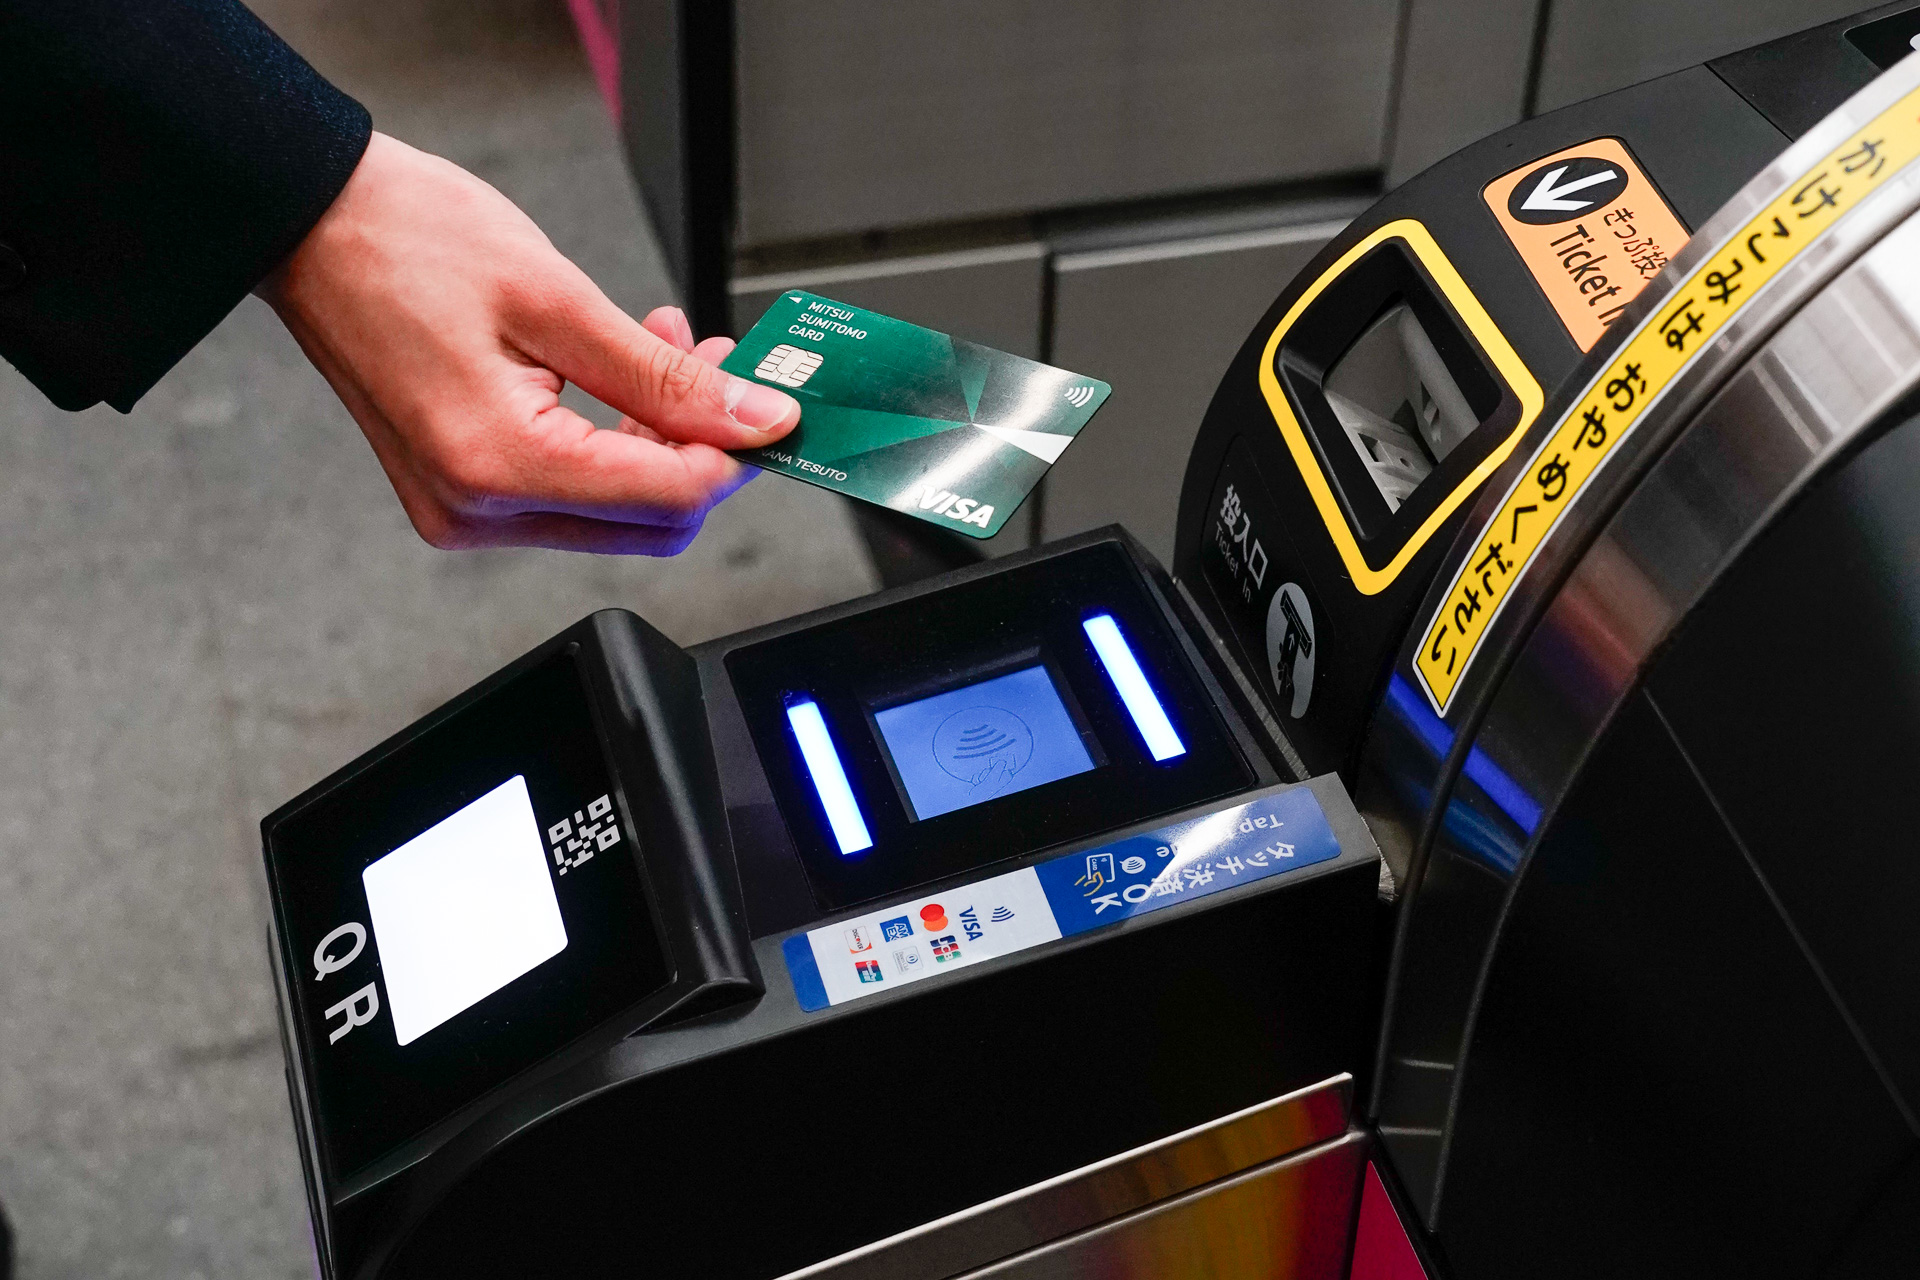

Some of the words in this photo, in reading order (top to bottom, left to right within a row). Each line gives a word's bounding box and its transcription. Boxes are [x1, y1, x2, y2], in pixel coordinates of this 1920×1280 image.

[1604, 207, 1668, 280] きっぷ投
[1659, 139, 1884, 353] かけこみは
[1550, 224, 1622, 306] Ticket
[1598, 301, 1631, 326] I
[797, 313, 867, 340] SUMITOMO
[808, 301, 854, 321] MITSUI
[788, 325, 824, 341] CARD
[795, 458, 847, 481] TESUTO
[919, 485, 994, 529] VISA
[1432, 363, 1650, 676] おやめください
[1220, 484, 1268, 590] 投入口
[1216, 521, 1239, 578] Ticket
[1243, 578, 1252, 603] In
[1239, 813, 1284, 834] Tap
[895, 922, 910, 940] AM
[959, 905, 982, 942] VISA
[938, 937, 955, 962] JCB
[313, 921, 380, 1046] QR
